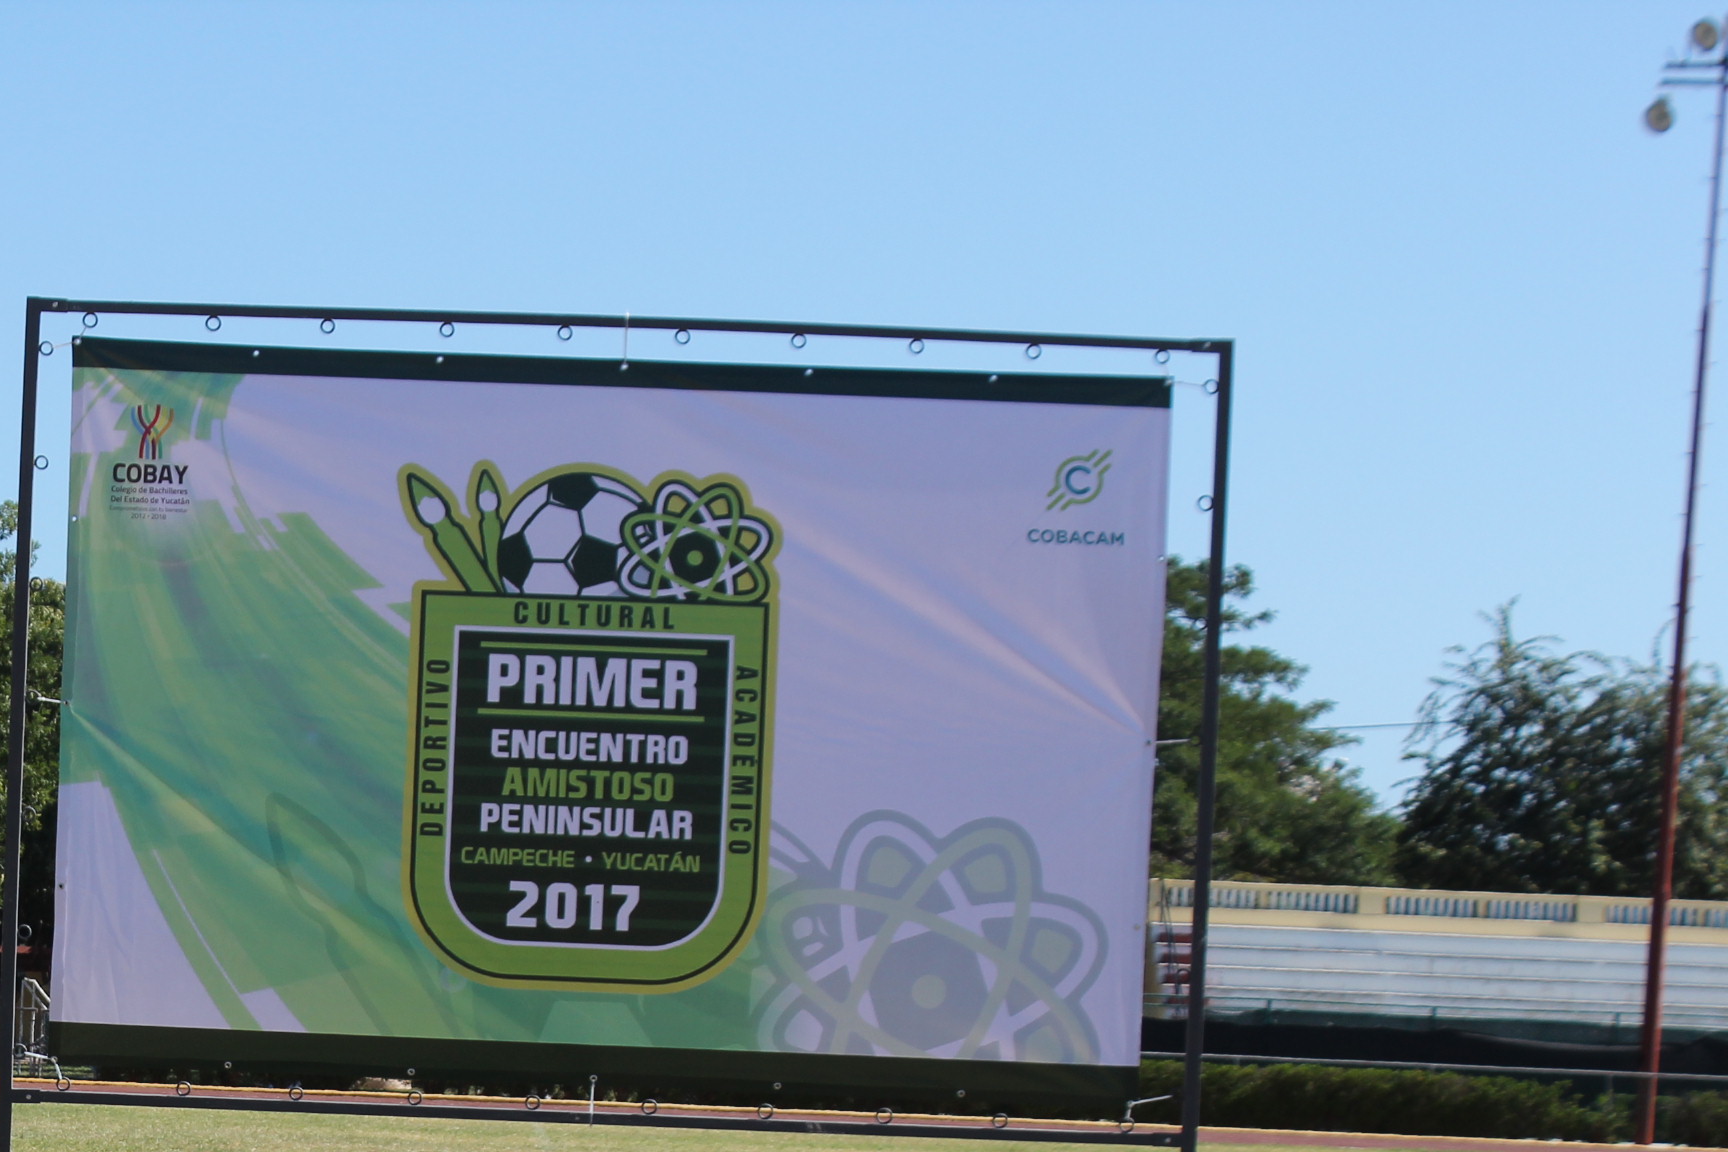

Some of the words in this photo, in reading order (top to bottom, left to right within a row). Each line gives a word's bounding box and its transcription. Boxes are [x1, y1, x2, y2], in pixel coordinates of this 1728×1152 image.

[111, 485, 137, 494] Colegio
[138, 486, 147, 494] de
[149, 486, 188, 495] Bachilleres
[113, 463, 188, 484] COBAY
[110, 495, 122, 503] Del
[124, 496, 149, 504] Estado
[160, 497, 190, 505] Yucatán
[1027, 528, 1124, 545] COBACAM
[514, 601, 675, 630] CULTURAL
[486, 653, 698, 711] PRIMER
[419, 658, 450, 838] DEPORTIVO
[490, 729, 689, 765] ENCUENTRO
[728, 665, 759, 856] ACADÉMICO
[501, 767, 674, 802] AMISTOSO
[480, 803, 693, 840] PENINSULAR
[461, 846, 575, 868] CAMPECHE
[602, 851, 701, 873] YUCATÁN
[505, 880, 641, 932] 2017
